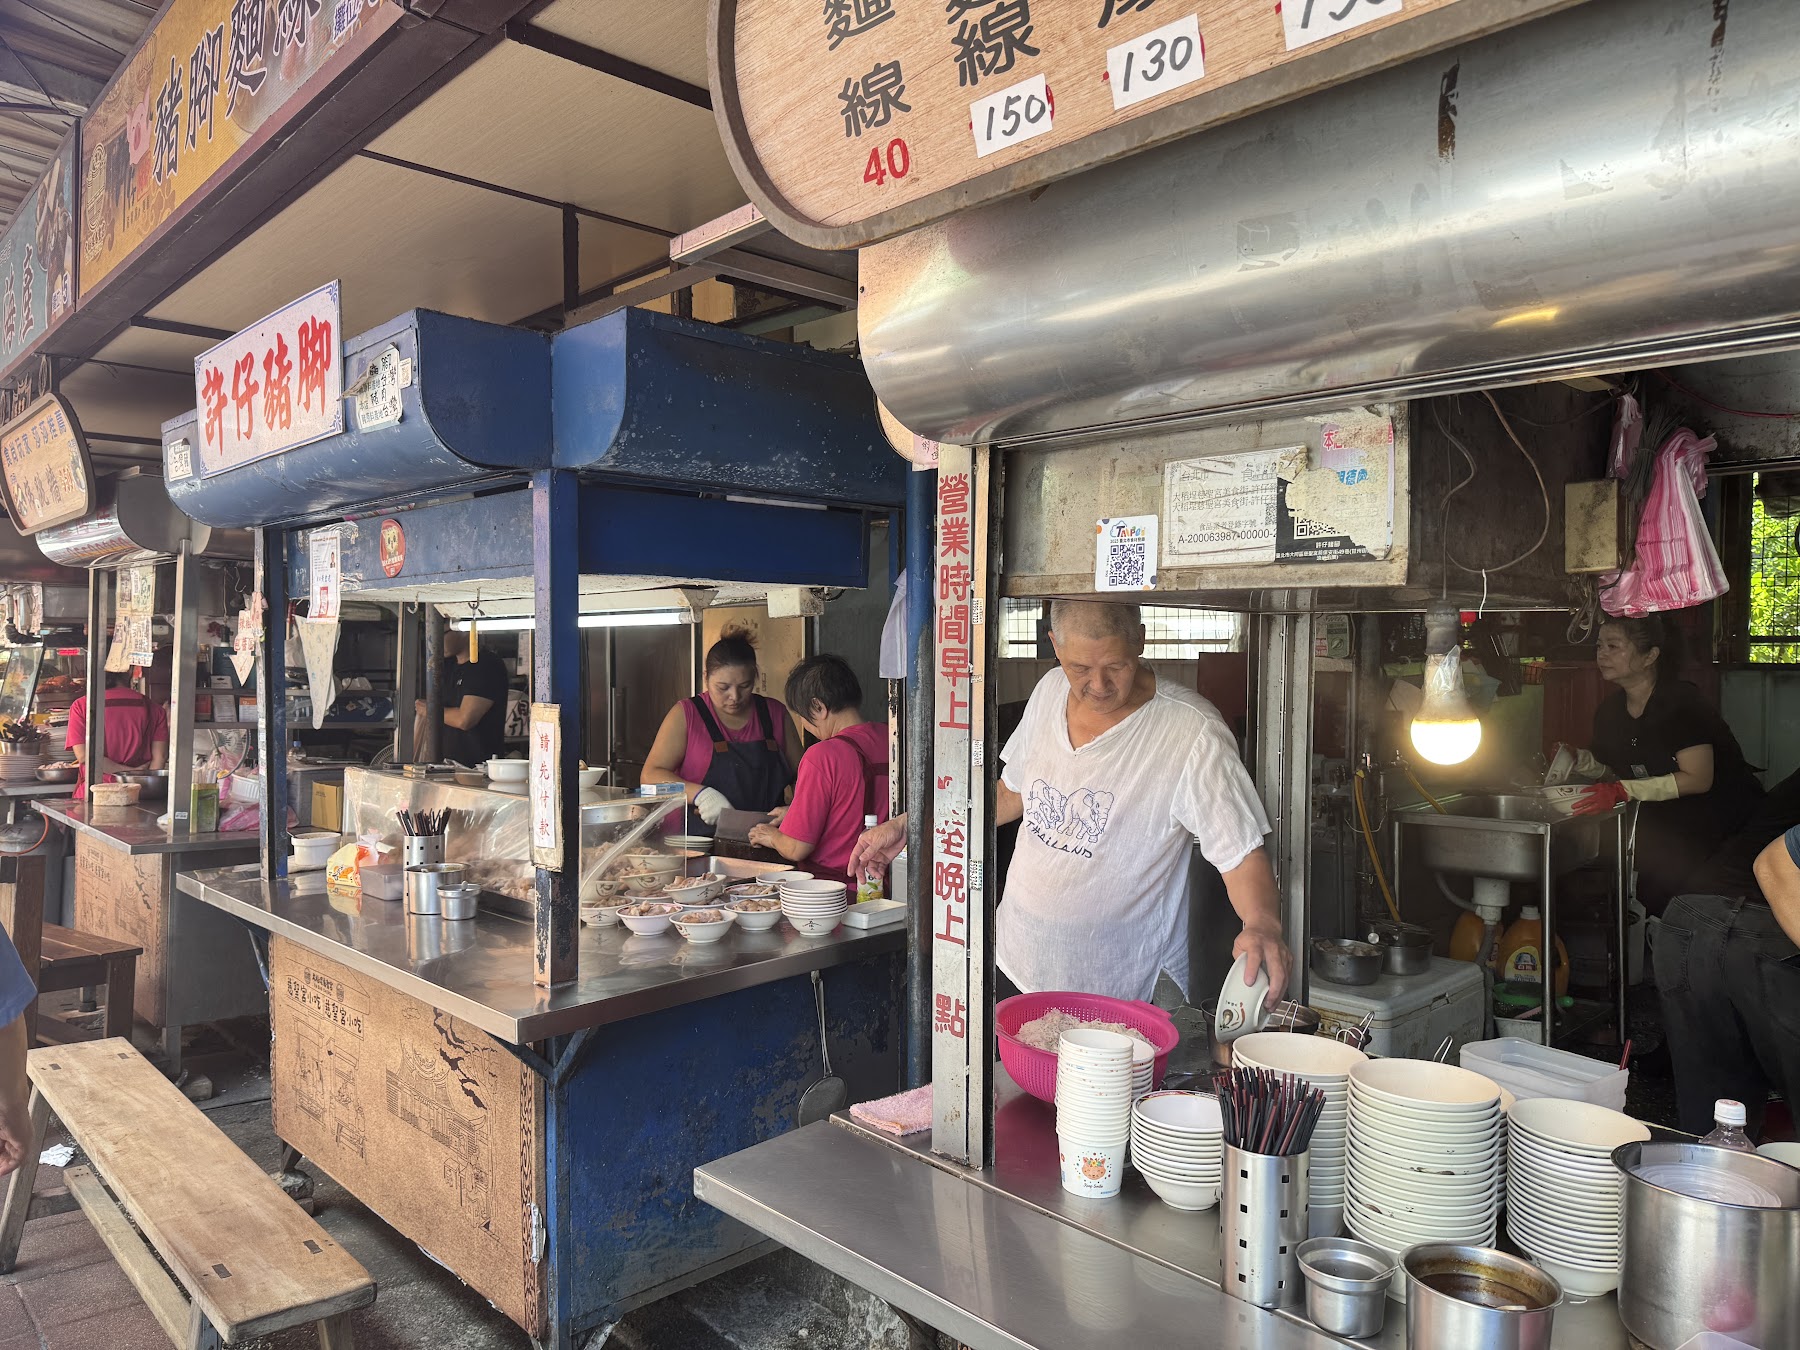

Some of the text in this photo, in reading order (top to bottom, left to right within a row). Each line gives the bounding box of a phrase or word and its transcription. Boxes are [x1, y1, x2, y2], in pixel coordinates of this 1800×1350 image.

[946, 0, 1041, 87] 線
[1122, 36, 1193, 92] 130
[986, 94, 1047, 141] 150
[863, 138, 910, 186] 40
[938, 472, 970, 730] 營業時間早上
[538, 733, 551, 838] 請先付款
